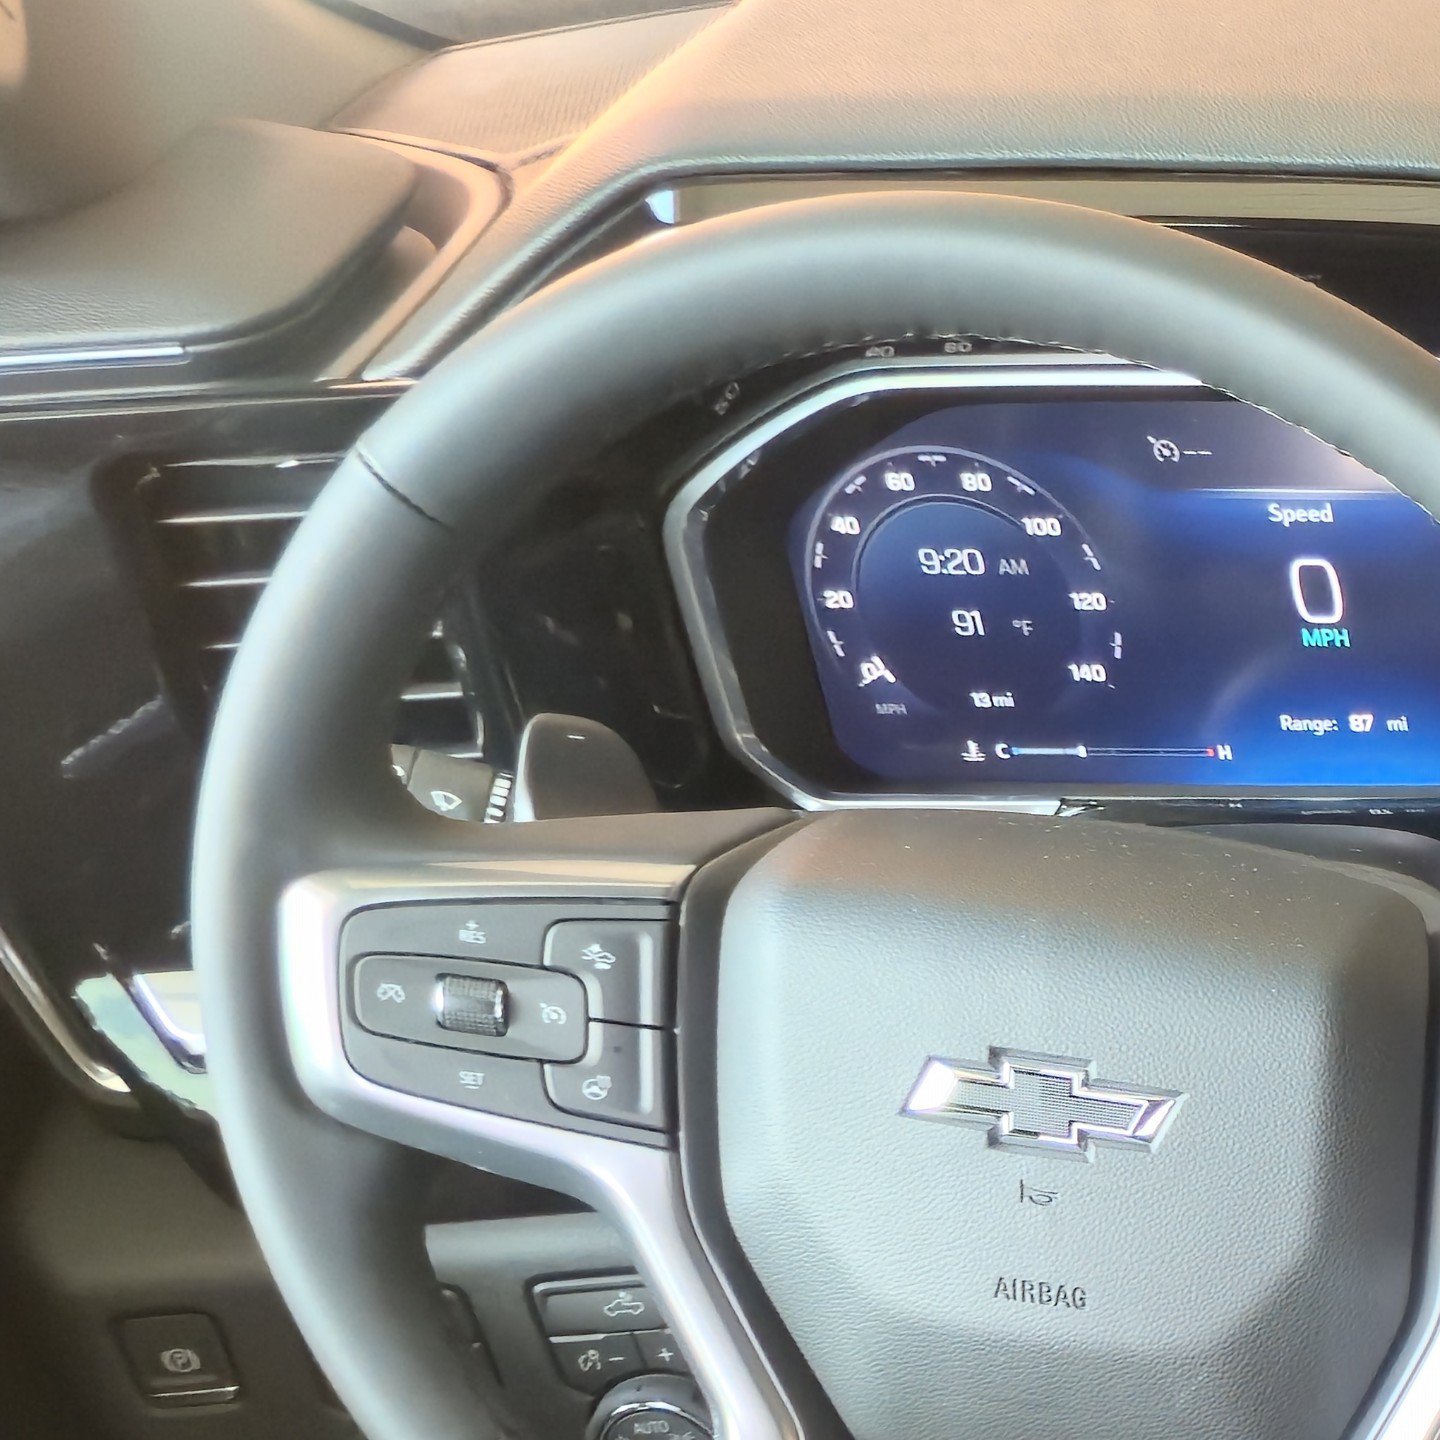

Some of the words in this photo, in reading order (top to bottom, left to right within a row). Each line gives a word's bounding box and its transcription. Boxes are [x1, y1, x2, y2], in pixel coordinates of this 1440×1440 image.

[885, 472, 915, 491] 60
[961, 472, 992, 492] 80
[1267, 503, 1334, 527] Speed
[830, 516, 860, 535] 40
[1022, 517, 1061, 536] 100
[918, 548, 985, 575] 9:20
[999, 558, 1029, 576] AM
[823, 590, 854, 609] 20
[1289, 557, 1344, 624] 0
[1069, 592, 1107, 611] 120
[951, 610, 985, 636] 91
[1301, 628, 1351, 648] MPH
[1068, 664, 1107, 683] 140
[969, 692, 992, 708] 13
[993, 692, 1015, 708] mi
[1279, 714, 1339, 735] Range:
[1348, 714, 1374, 732] 87
[1387, 715, 1409, 732] mi
[994, 743, 1010, 760] C
[1216, 745, 1232, 761] H
[459, 1070, 485, 1085] SET
[994, 1277, 1087, 1310] AIRBAG
